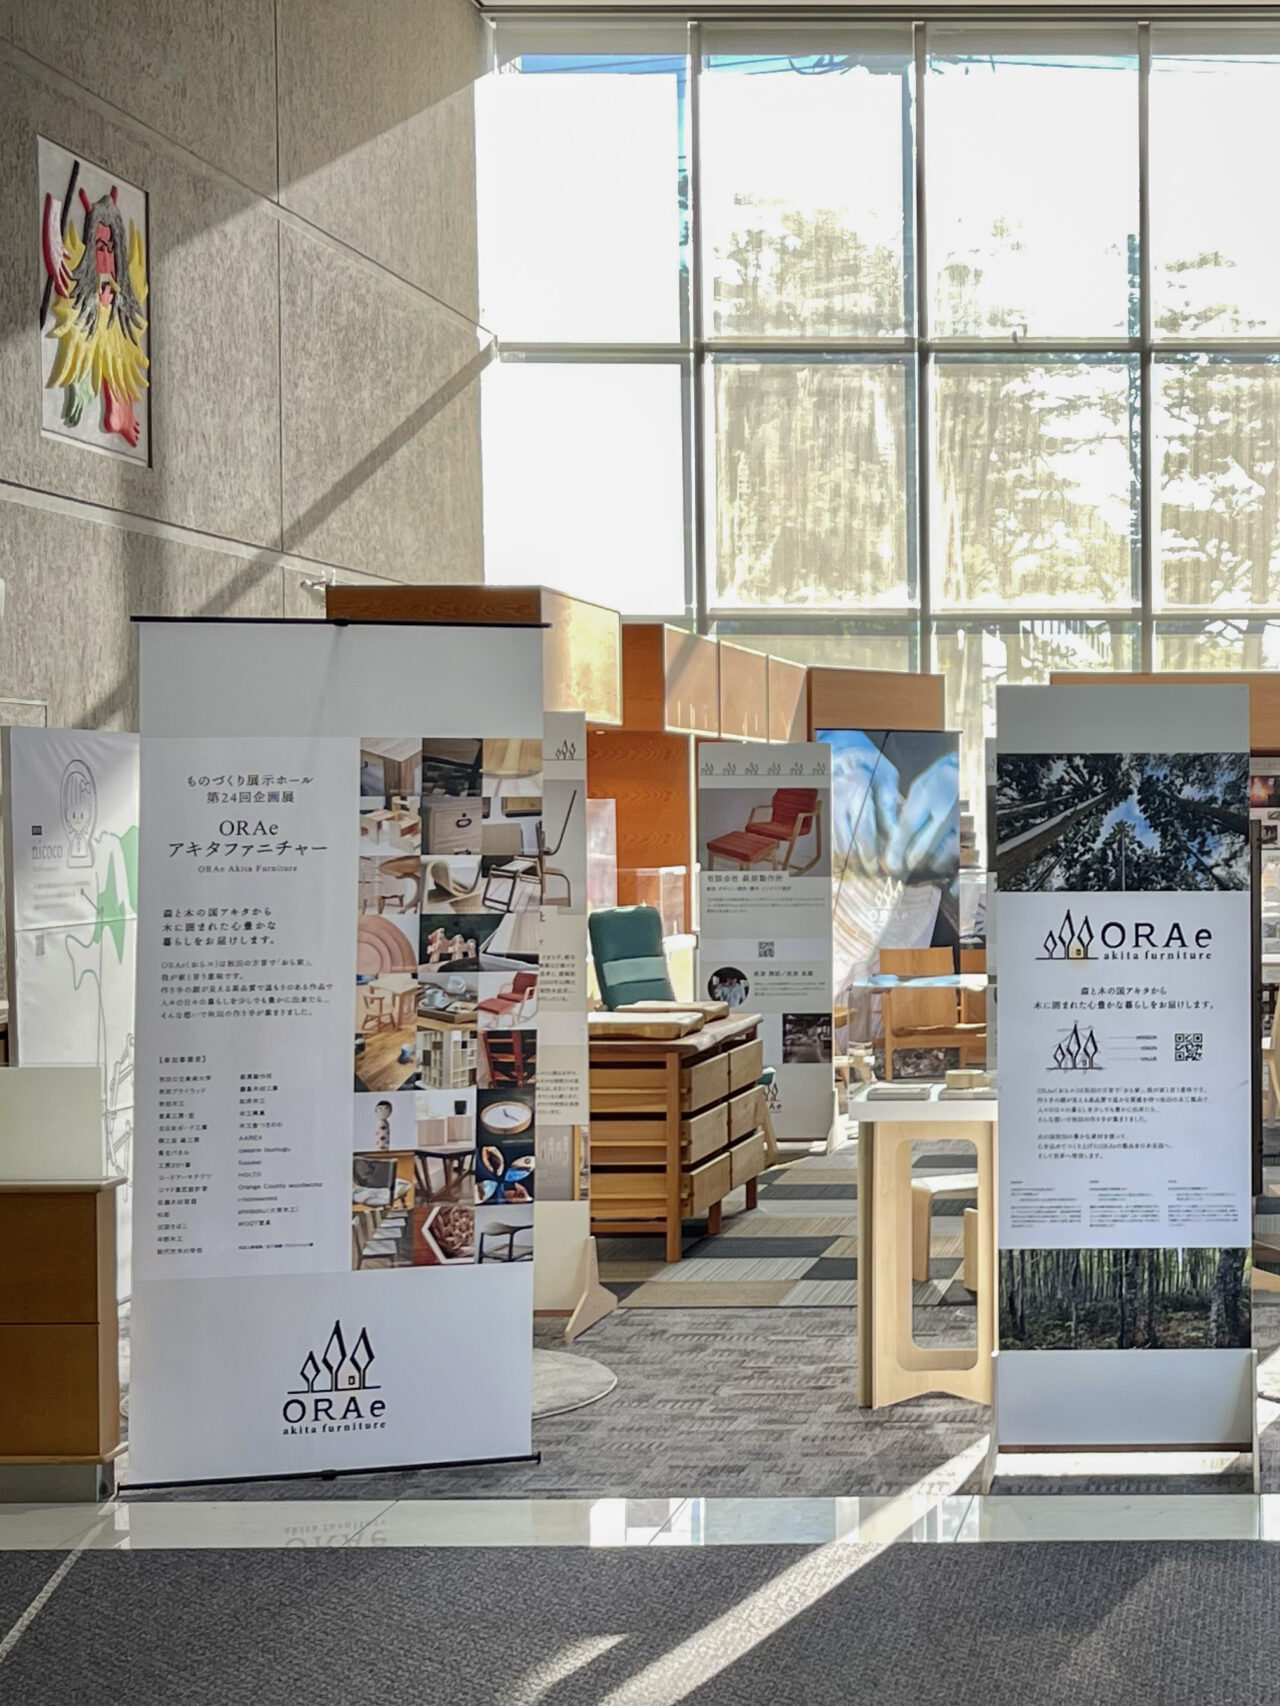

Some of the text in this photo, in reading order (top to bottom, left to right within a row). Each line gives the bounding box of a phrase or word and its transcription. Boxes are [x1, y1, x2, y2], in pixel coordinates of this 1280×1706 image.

[187, 775, 313, 787] ものづくり展示ホール
[207, 791, 294, 803] 第24回企画展
[219, 820, 278, 836] ORAe
[169, 840, 327, 857] アキタファニチャー
[198, 865, 225, 873] ORAe
[228, 864, 253, 873] Akita
[163, 907, 272, 918] 森と木の国アキタから
[163, 921, 276, 932] 木に囲まれた心豊かな
[163, 936, 275, 946] 暮らしをお届けします。
[1101, 922, 1212, 948] ORAe
[1103, 950, 1212, 960] akita furniture
[1081, 986, 1167, 995] 森と木の国アキタから
[283, 1396, 386, 1423] ORAe
[283, 1421, 386, 1435] akita furniture
